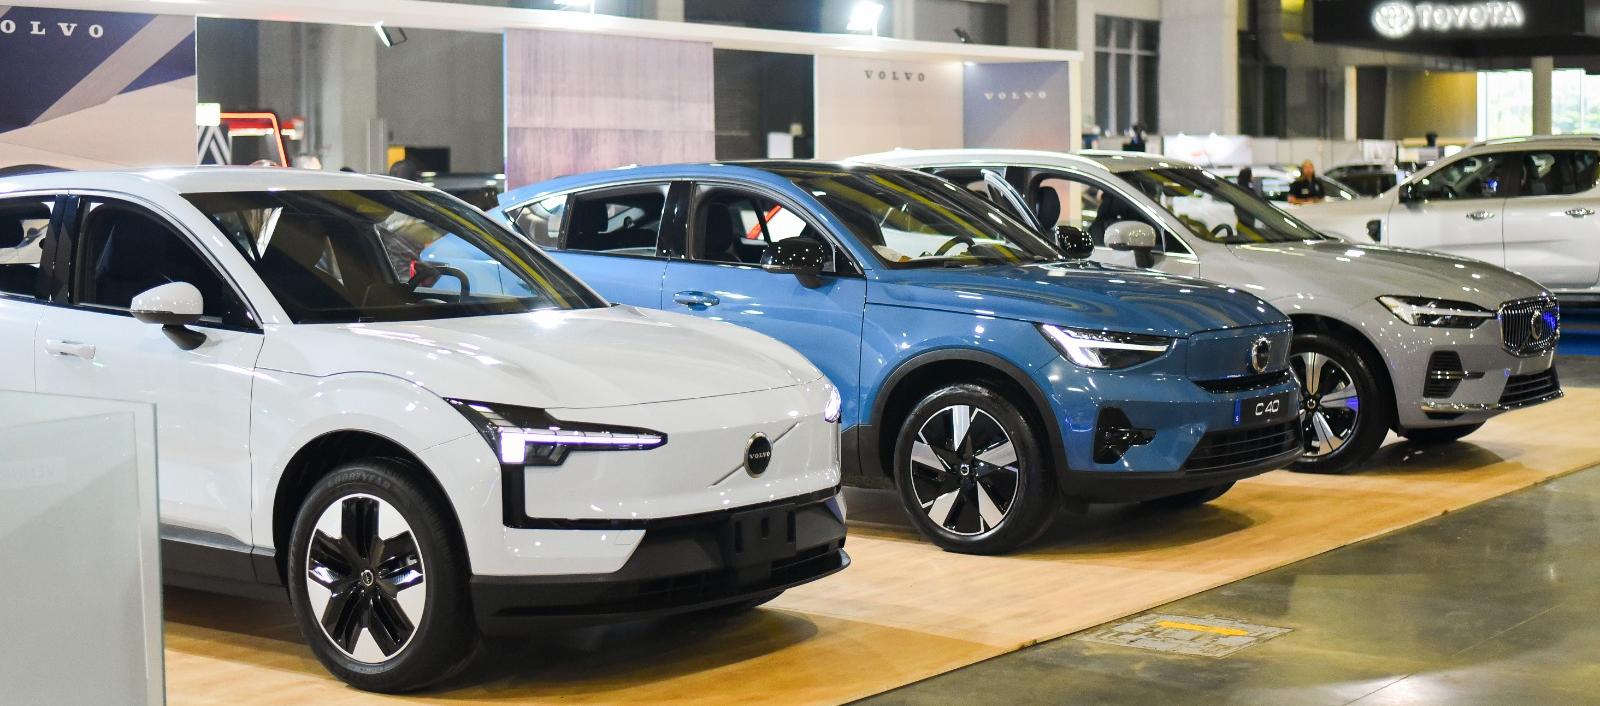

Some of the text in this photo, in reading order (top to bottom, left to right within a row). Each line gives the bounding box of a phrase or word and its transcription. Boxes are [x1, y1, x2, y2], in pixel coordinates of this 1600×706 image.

[1416, 2, 1524, 31] TOYOTA
[864, 70, 925, 82] VOLVO
[984, 91, 1047, 100] VOLVO
[749, 451, 771, 459] VOLVO
